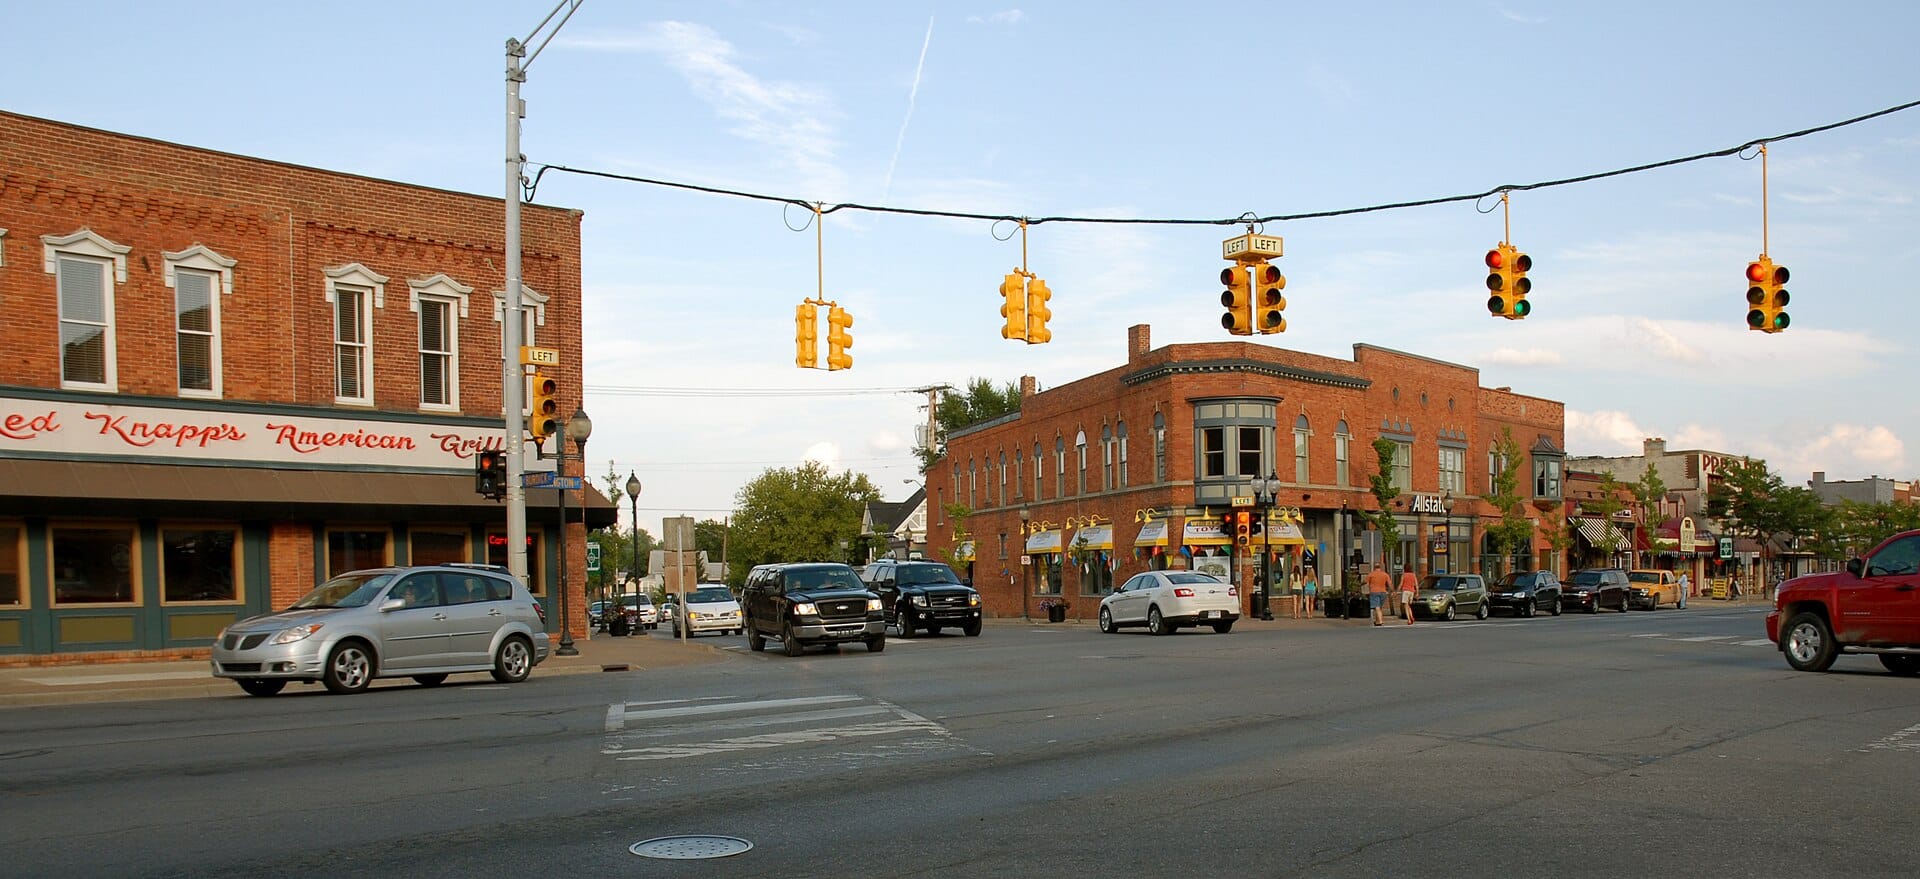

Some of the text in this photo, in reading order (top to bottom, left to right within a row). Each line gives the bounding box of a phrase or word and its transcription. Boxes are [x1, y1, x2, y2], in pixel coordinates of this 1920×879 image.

[1226, 240, 1245, 254] LEFT
[1254, 239, 1277, 251] LEFT
[532, 350, 553, 362] LEFT
[0, 411, 504, 459] ed Knapp's American Grill
